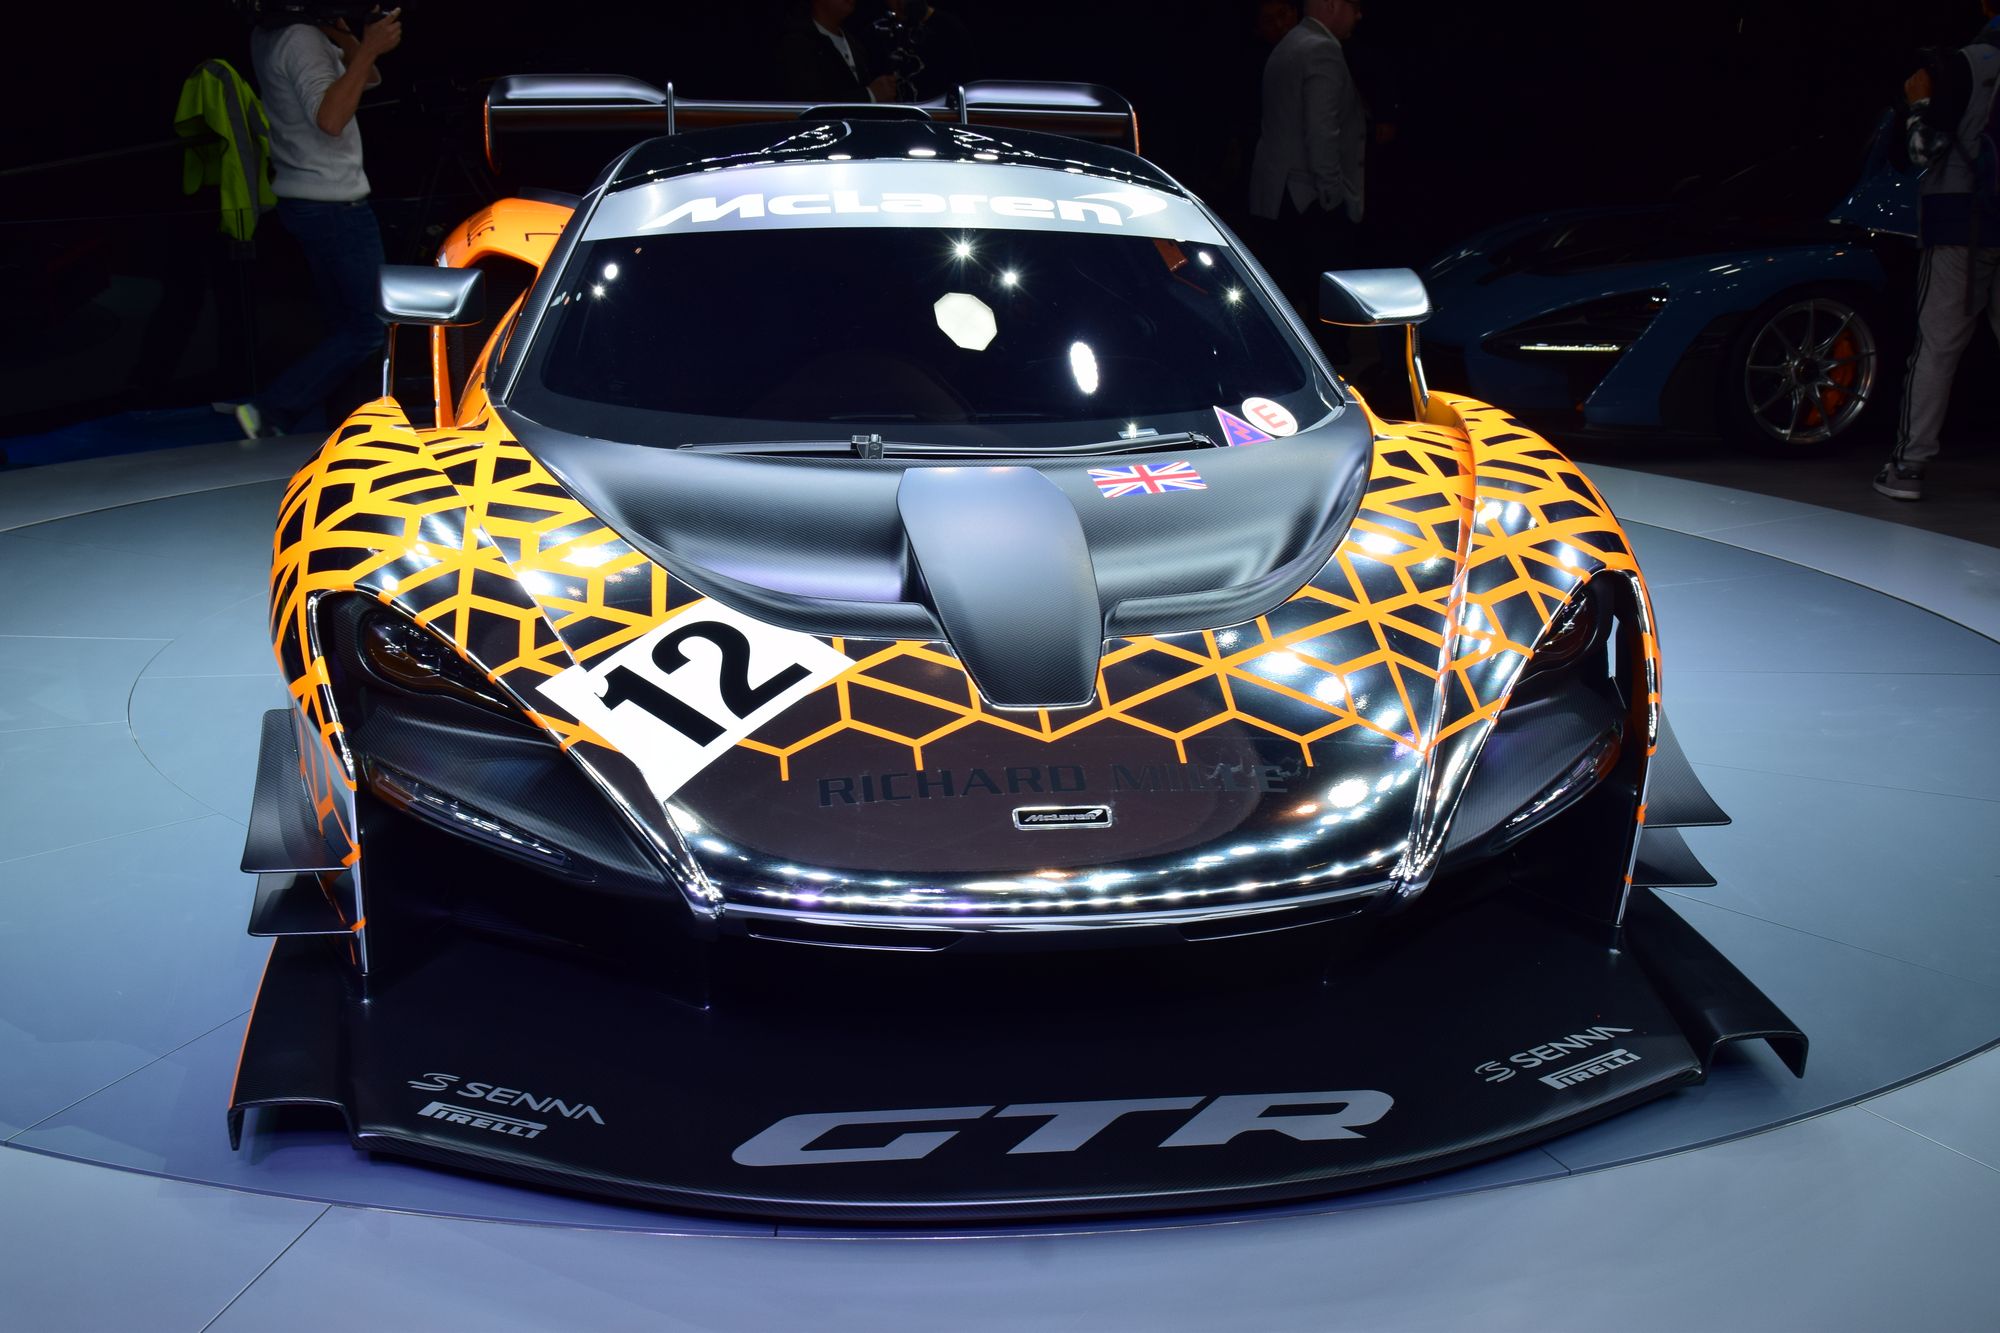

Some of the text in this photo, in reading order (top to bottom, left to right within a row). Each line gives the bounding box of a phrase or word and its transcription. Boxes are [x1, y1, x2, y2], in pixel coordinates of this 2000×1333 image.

[637, 189, 1125, 230] McLaren
[1252, 404, 1288, 429] E
[594, 620, 813, 748] 12
[817, 763, 1288, 807] RICHARD MILLE
[1024, 810, 1101, 823] McLaren
[1509, 1026, 1633, 1068] SENNA
[1538, 1048, 1642, 1090] PIRELLI
[417, 1101, 548, 1139] PIRELLI
[456, 1082, 605, 1125] SENNA
[731, 1089, 1395, 1167] GTR
